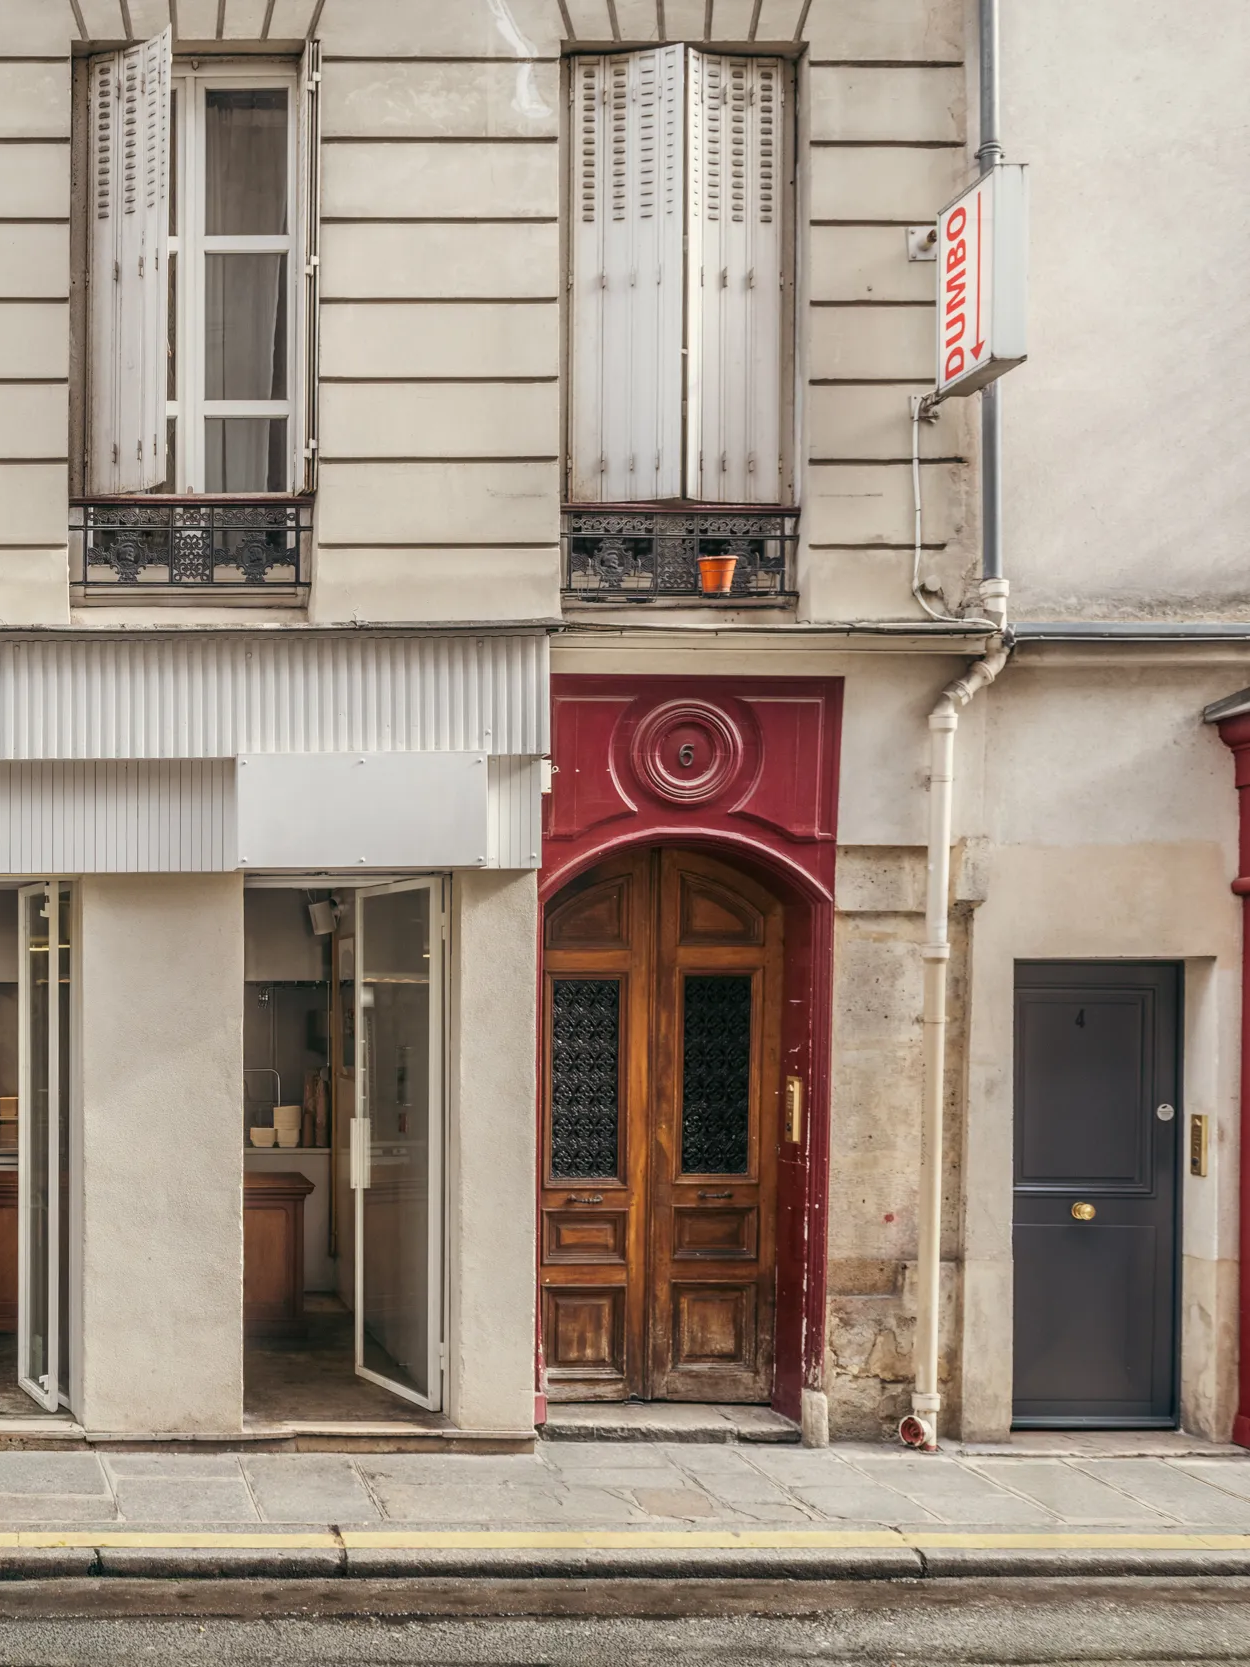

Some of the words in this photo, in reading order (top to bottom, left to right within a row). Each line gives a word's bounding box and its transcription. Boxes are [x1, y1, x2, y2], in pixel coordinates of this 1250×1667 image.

[945, 206, 967, 381] DUMBO
[678, 743, 695, 767] 6
[1074, 1008, 1085, 1028] 4
